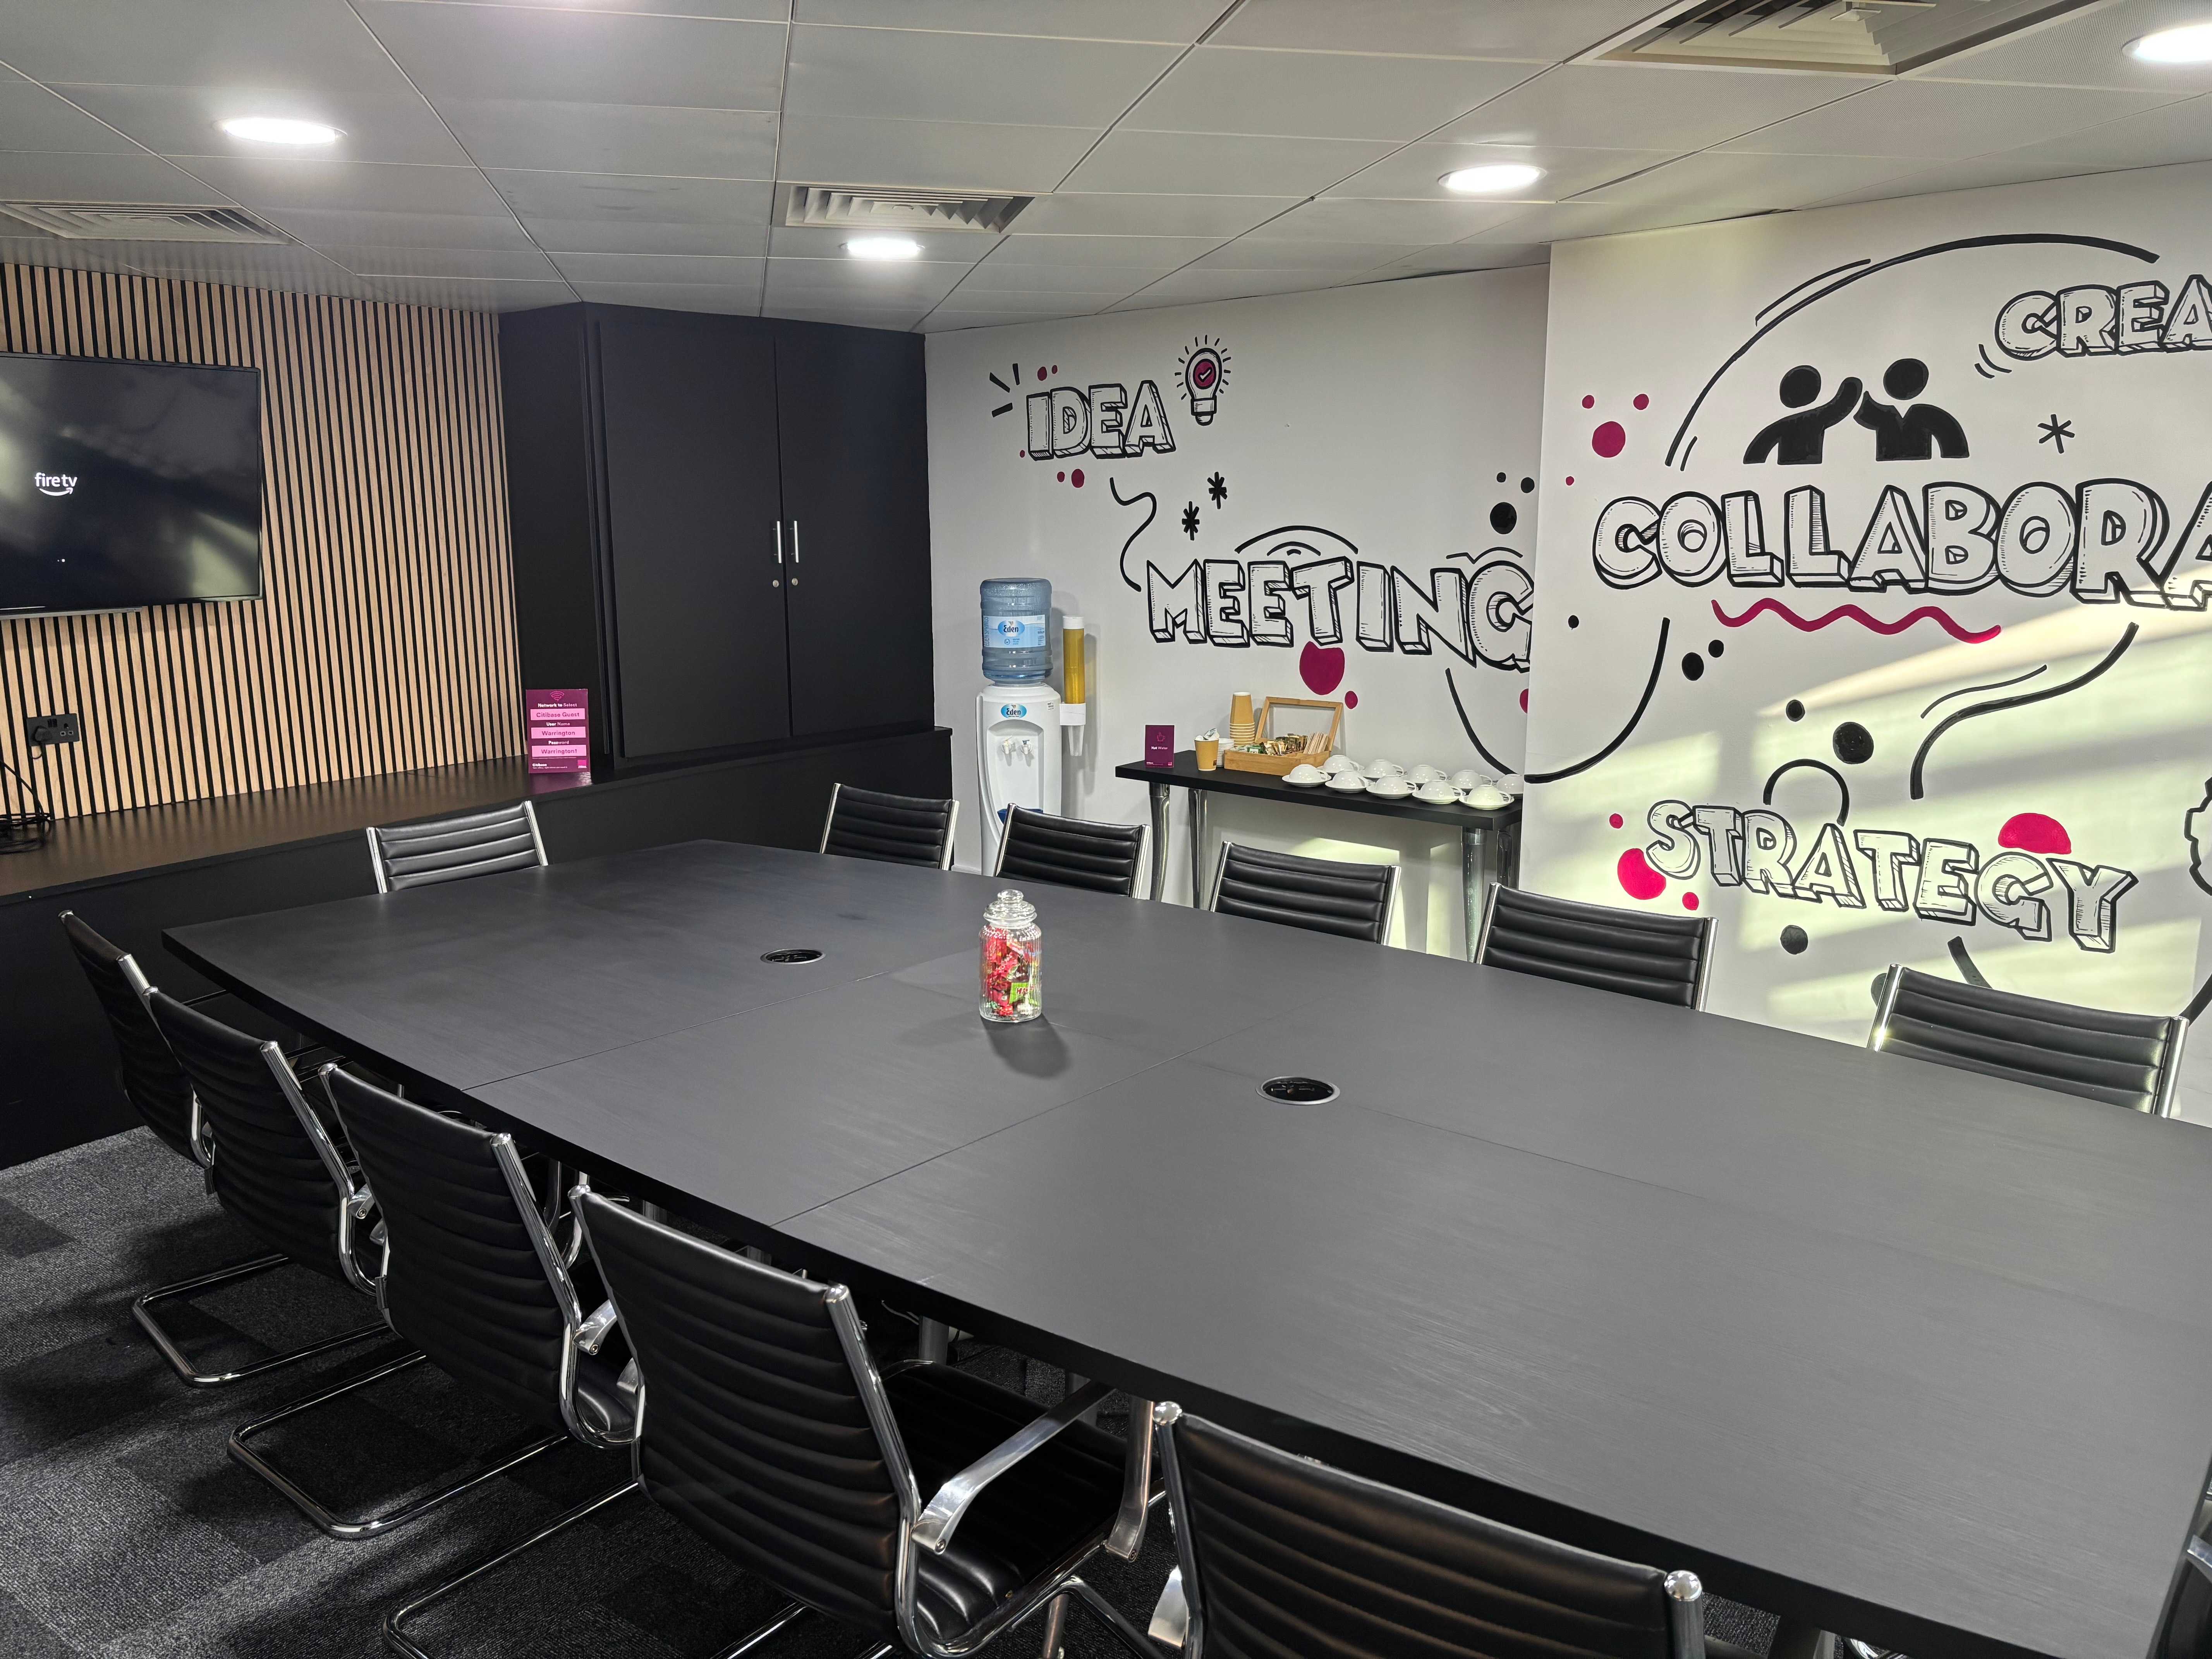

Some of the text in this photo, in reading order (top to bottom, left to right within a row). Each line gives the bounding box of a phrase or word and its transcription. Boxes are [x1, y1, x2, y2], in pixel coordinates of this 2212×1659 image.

[1995, 274, 2212, 361] CREA
[1026, 380, 1176, 461] IDEA
[1003, 625, 1018, 633] Eden
[1147, 556, 1534, 673] MEETING
[1646, 800, 2138, 953] STRATEGY
